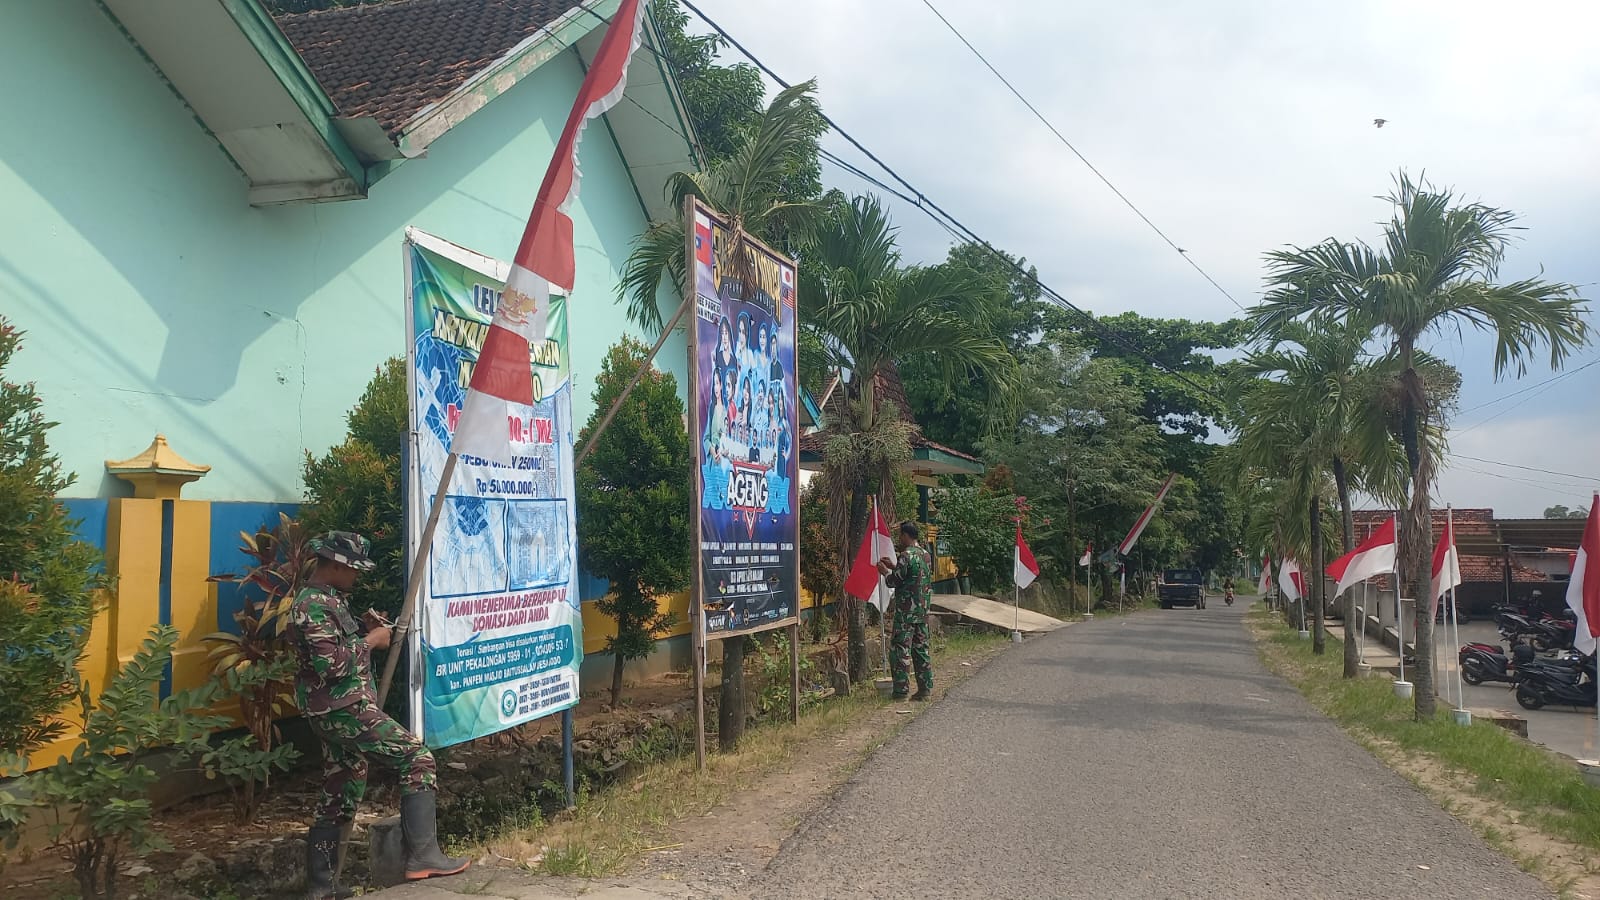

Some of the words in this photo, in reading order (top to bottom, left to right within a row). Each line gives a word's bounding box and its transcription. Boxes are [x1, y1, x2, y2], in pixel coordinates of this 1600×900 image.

[727, 471, 768, 507] AGENG
[447, 601, 473, 618] KAMI
[472, 594, 520, 615] MENERIMA
[472, 612, 505, 632] DONASI
[507, 609, 528, 627] DARI
[528, 606, 549, 623] ANDA
[448, 660, 465, 674] UNIT
[466, 652, 506, 671] PEKALONGAN
